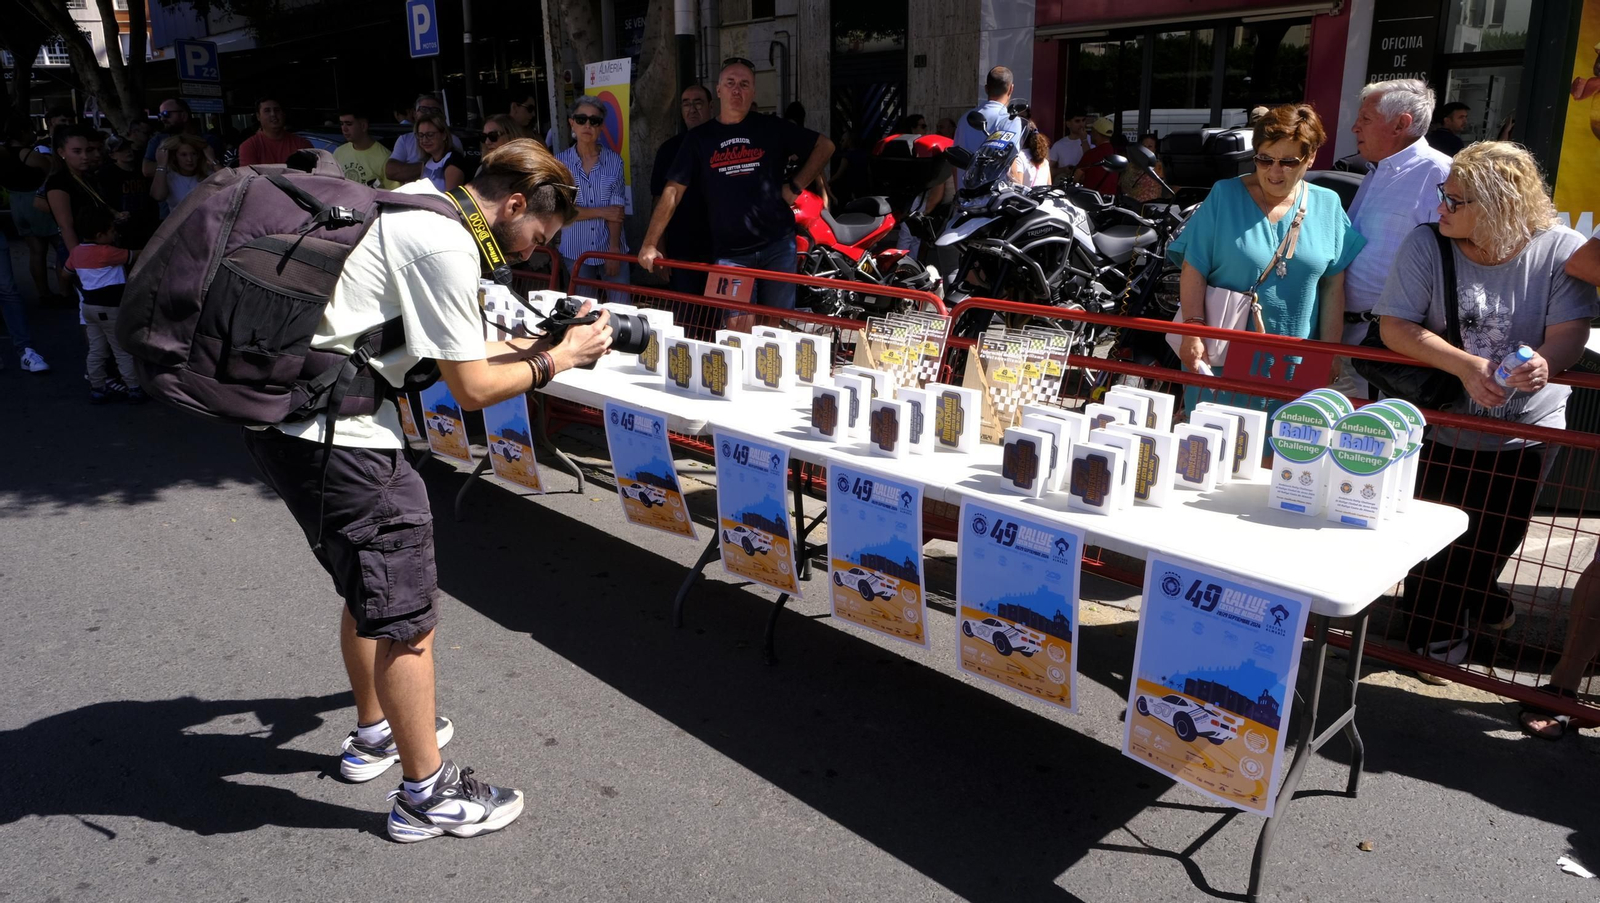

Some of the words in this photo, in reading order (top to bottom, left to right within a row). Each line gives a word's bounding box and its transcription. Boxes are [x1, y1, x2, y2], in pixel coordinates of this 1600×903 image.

[412, 4, 431, 50] P
[624, 19, 632, 30] SE
[422, 42, 437, 50] MOTOS
[1381, 35, 1423, 51] OFICINA
[184, 44, 210, 77] P
[1393, 54, 1407, 68] DE
[720, 138, 751, 149] SUPERIOR
[469, 212, 490, 242] D500
[1026, 226, 1053, 237] TRIUMPH
[486, 242, 500, 264] Nikon
[621, 412, 634, 431] 49
[944, 396, 952, 441] ANIVERSARIO
[1279, 422, 1322, 445] Rally
[1339, 432, 1385, 457] Rally
[733, 443, 749, 466] 49
[1278, 440, 1320, 454] Challenge
[1188, 440, 1198, 477] ANIVERSARIO
[1338, 451, 1383, 466] Challenge
[852, 477, 873, 502] 49
[873, 482, 901, 501] RALLYE
[1087, 460, 1098, 500] ANIVERSARIO
[990, 518, 1018, 547] 49
[1018, 525, 1054, 548] RALLYE
[1184, 579, 1222, 612] 49
[1221, 588, 1270, 615] RALLYE
[1218, 603, 1234, 614] COSTA
[1234, 607, 1242, 616] DE
[1229, 614, 1250, 626] SEPTIEMBRE
[1250, 620, 1261, 629] 2024
